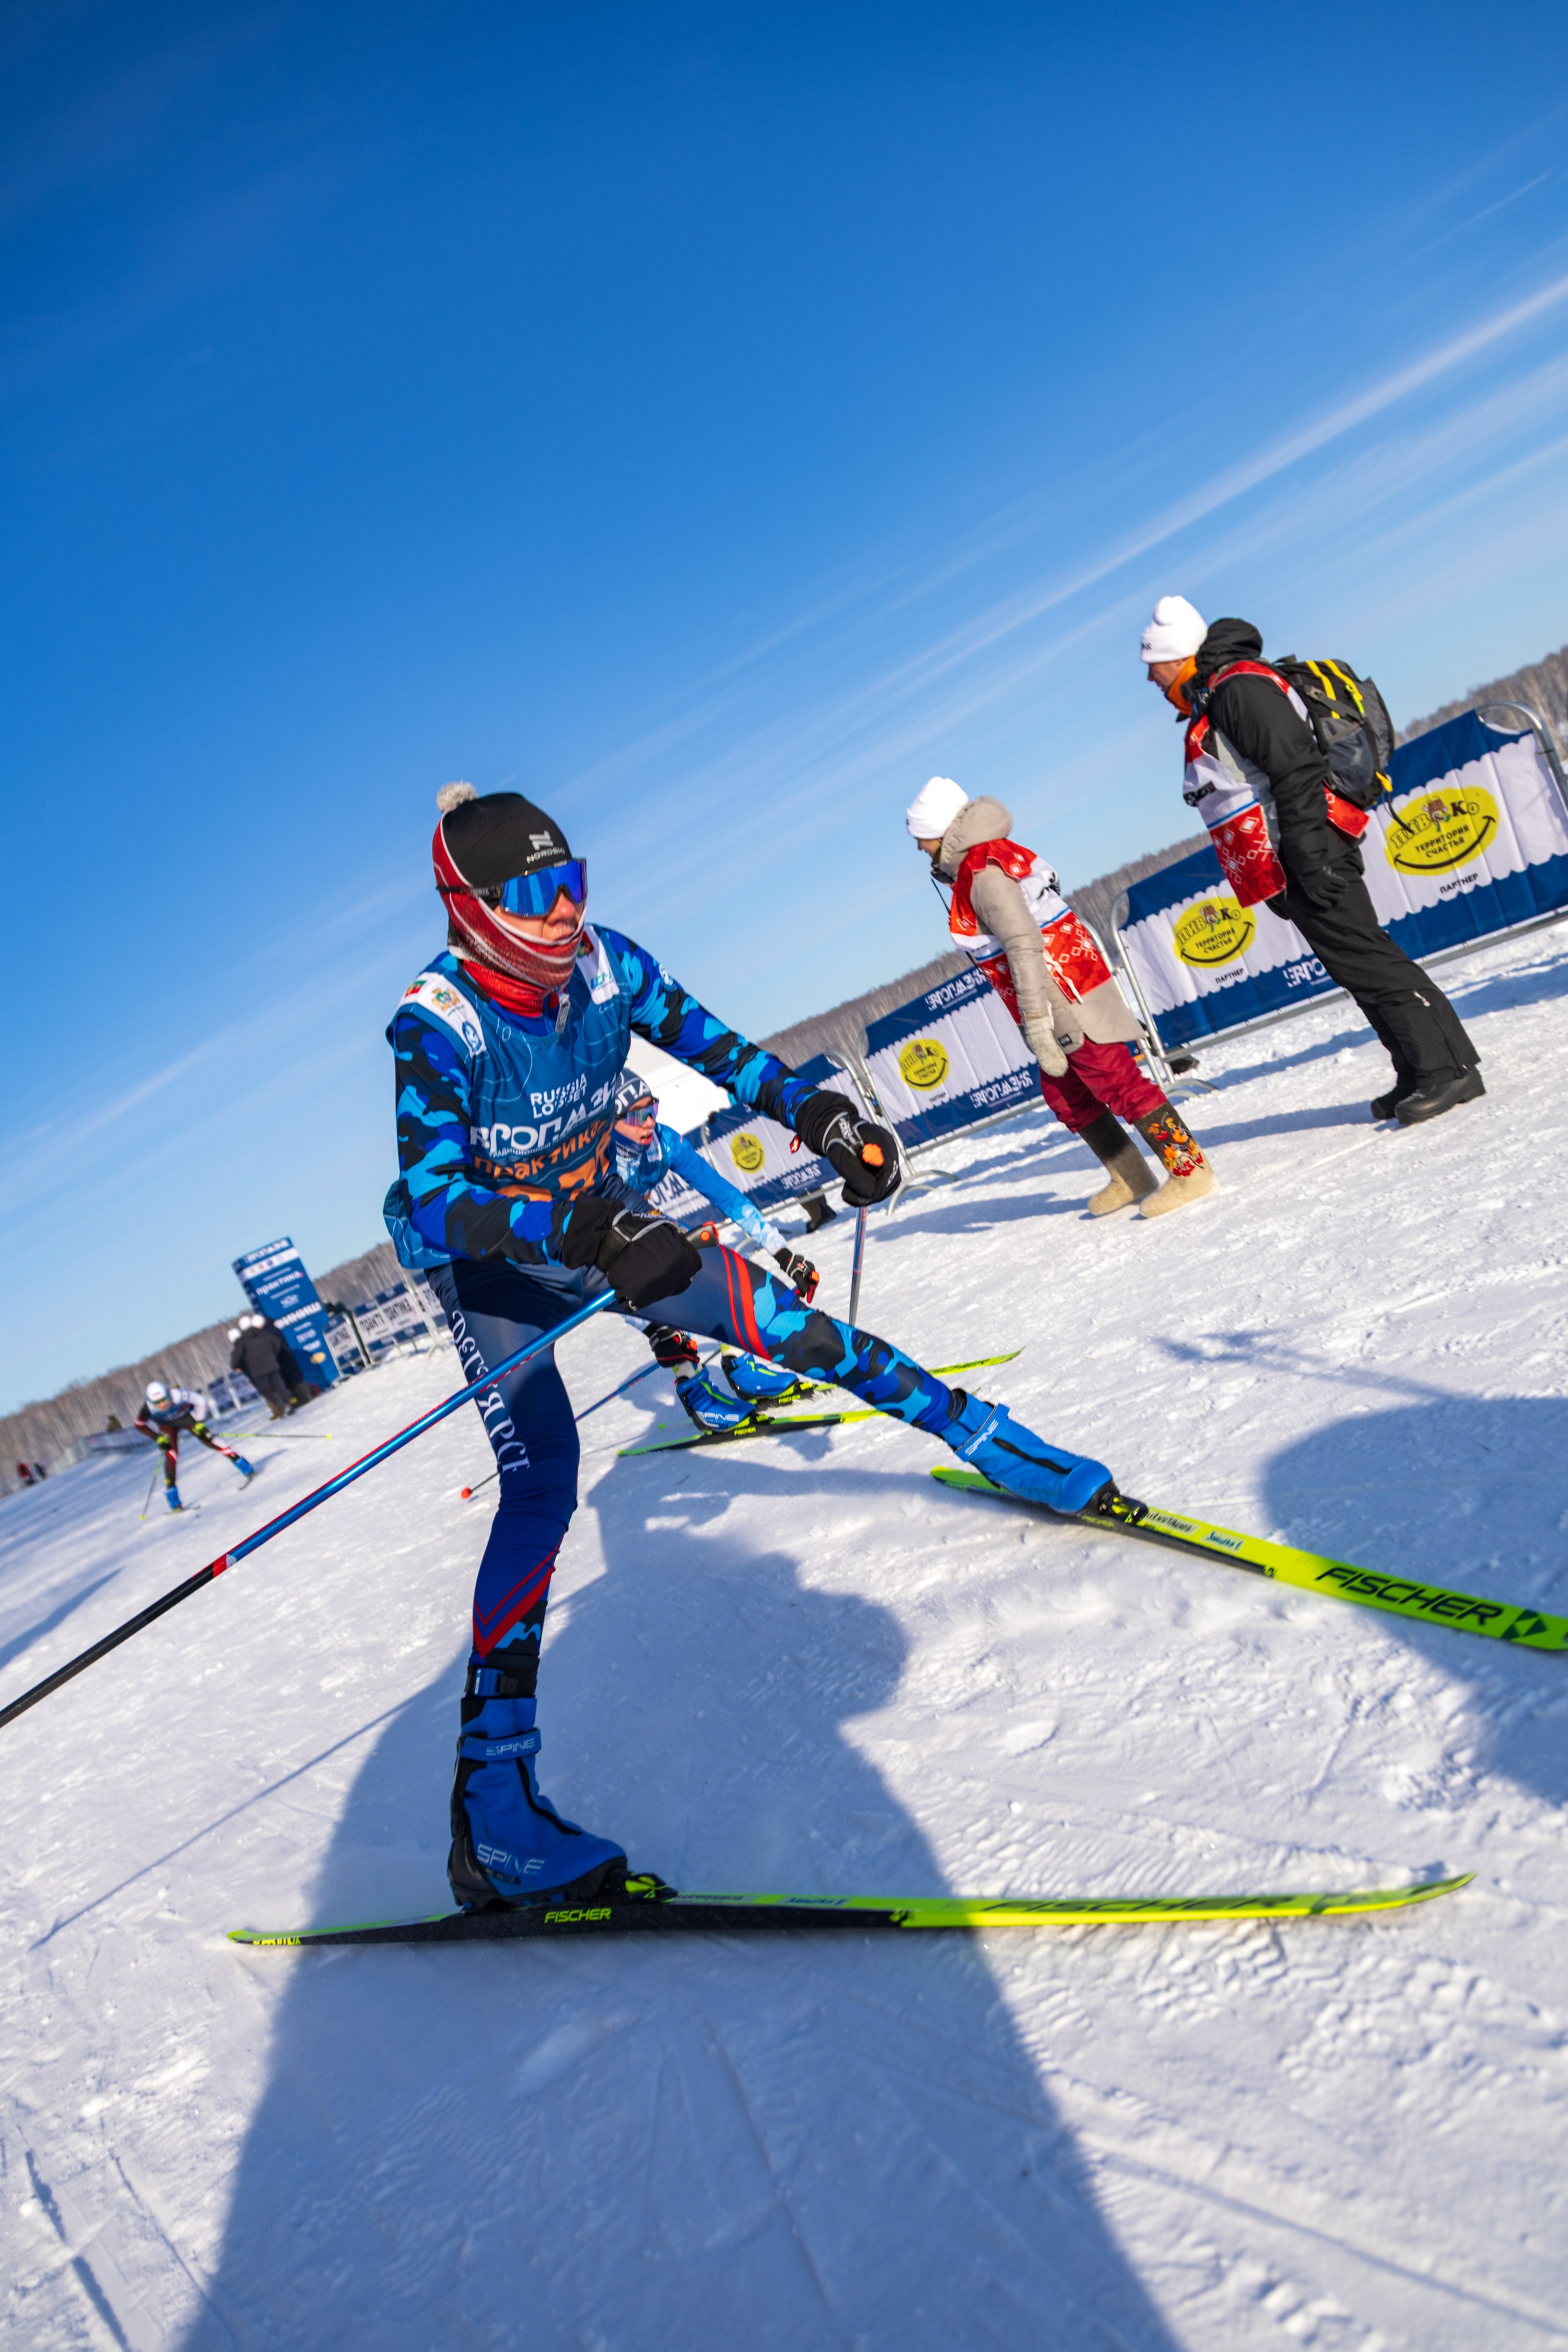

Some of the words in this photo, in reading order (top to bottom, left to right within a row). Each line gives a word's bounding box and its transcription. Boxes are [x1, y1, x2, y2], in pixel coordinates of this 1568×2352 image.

[1415, 824, 1470, 853] ТЕРРИТОРИЯ
[1426, 837, 1465, 858] СЧАСТЬЯ
[526, 846, 565, 864] NORDSKI
[1439, 873, 1479, 894] ПАРТНЕР
[1196, 927, 1235, 949] ТЕРРИТОРИЯ
[1204, 938, 1232, 953] СЧАСТЬЯ
[1215, 968, 1244, 984] ПАРТНЕР
[530, 1073, 587, 1106] RUSSIA
[256, 1271, 301, 1296] практика
[778, 1395, 801, 1404] FISCHER
[734, 1427, 756, 1436] FISCHER
[965, 1419, 999, 1456] SPINE
[1314, 1567, 1504, 1626] FISCHER
[486, 1738, 536, 1756] SPINE
[477, 1843, 546, 1875] SPINE
[545, 1908, 612, 1924] FISCHER
